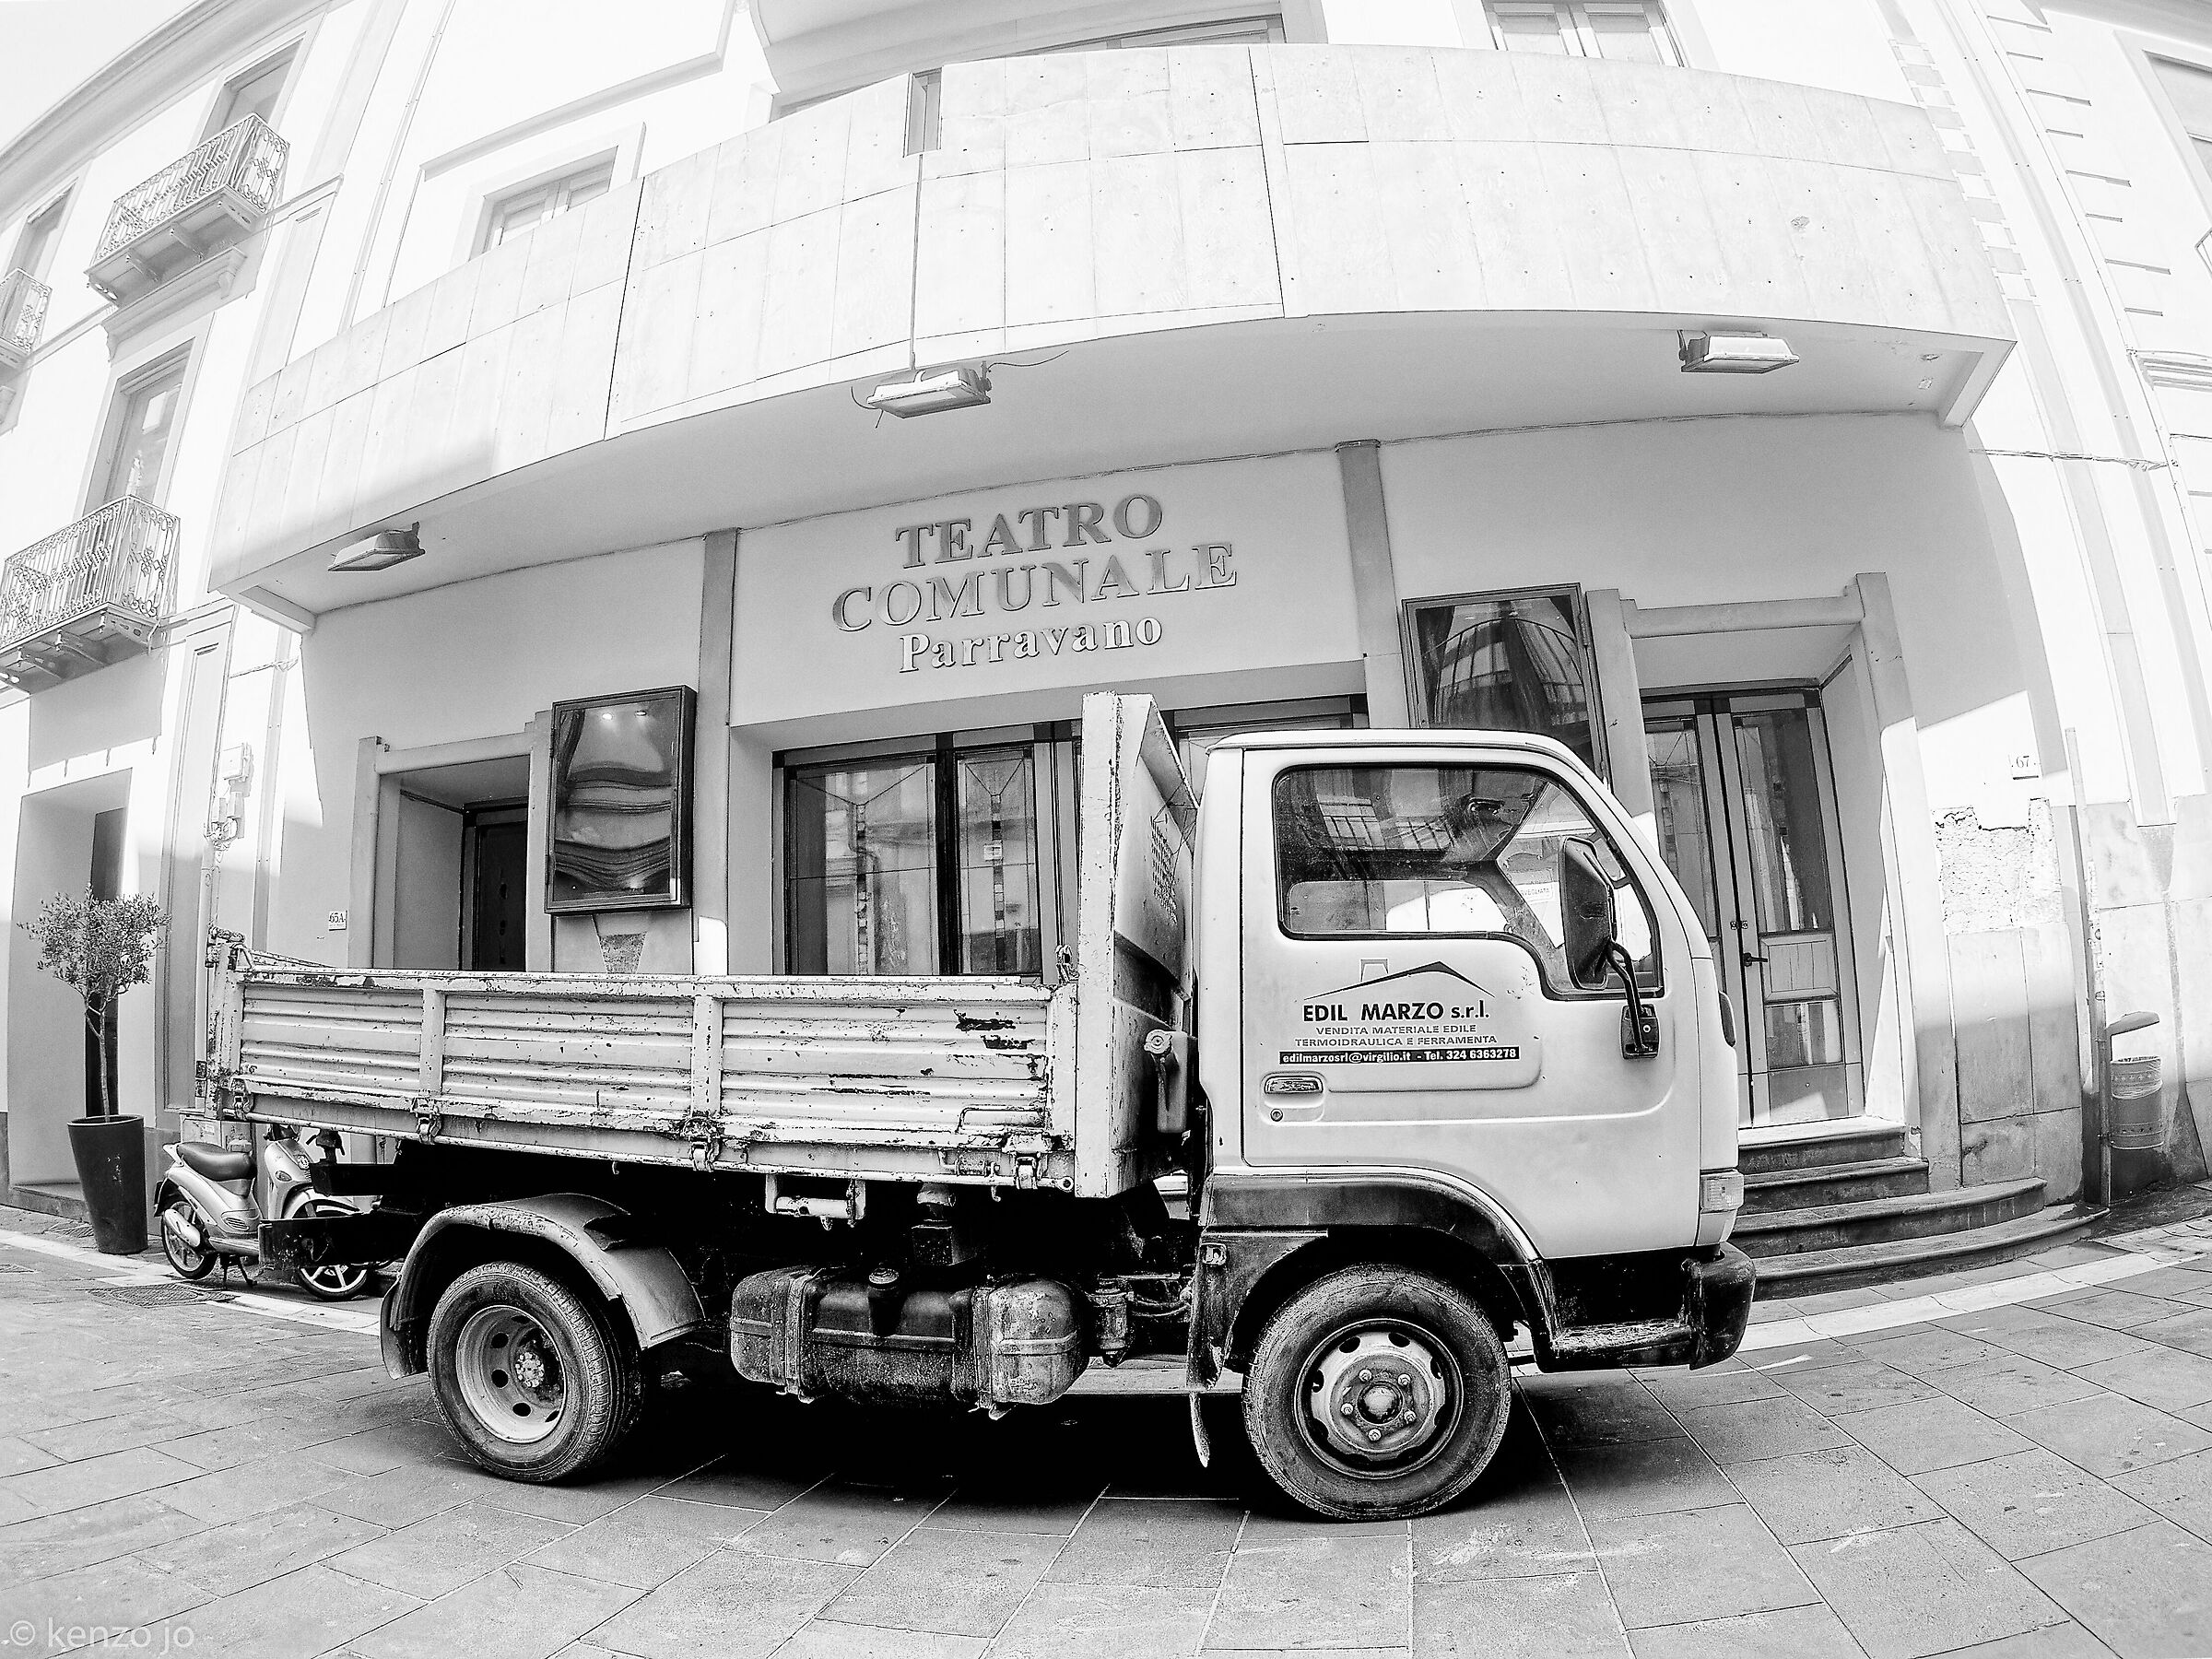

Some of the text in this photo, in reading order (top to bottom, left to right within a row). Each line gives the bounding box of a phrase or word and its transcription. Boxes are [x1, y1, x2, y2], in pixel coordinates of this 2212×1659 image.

[895, 493, 1163, 570] TEATRO
[831, 542, 1238, 632] COMUNALE
[899, 617, 1163, 674] Parravano
[1303, 999, 1490, 1022] EDIL MARZO s.r.l.
[1295, 1035, 1498, 1047] TERMOIDRAULICA E FERRAMENTA
[1315, 1024, 1477, 1035] VENDITA MATERIALE EDILE
[1282, 1051, 1411, 1064] edilmarzosrl@virgilio.it
[1424, 1051, 1443, 1061] Tel.
[1445, 1050, 1467, 1060] 324
[1469, 1048, 1517, 1059] 6363278
